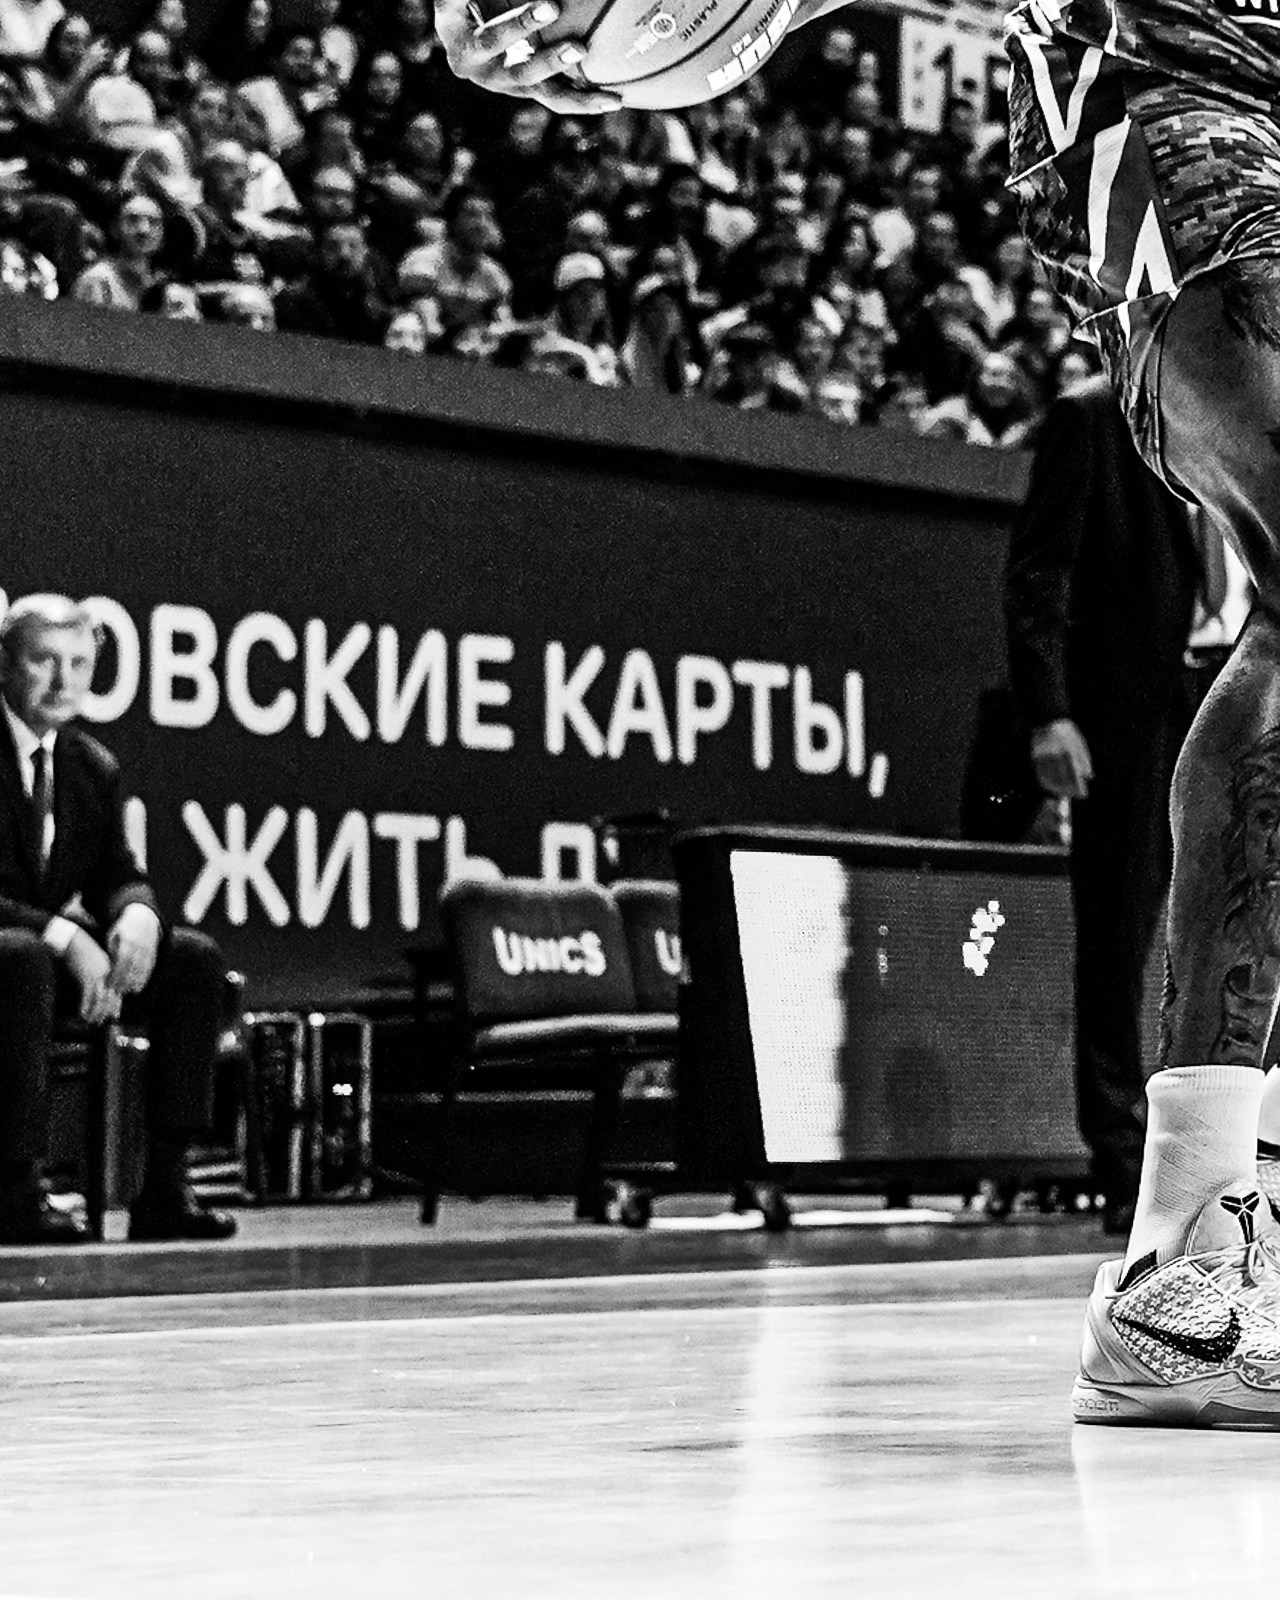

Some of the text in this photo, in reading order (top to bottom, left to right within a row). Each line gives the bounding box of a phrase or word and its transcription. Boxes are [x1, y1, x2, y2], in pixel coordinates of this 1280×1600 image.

[0, 587, 890, 799] ОВСКИЕ КАРТЫ,
[492, 926, 607, 977] UNICS
